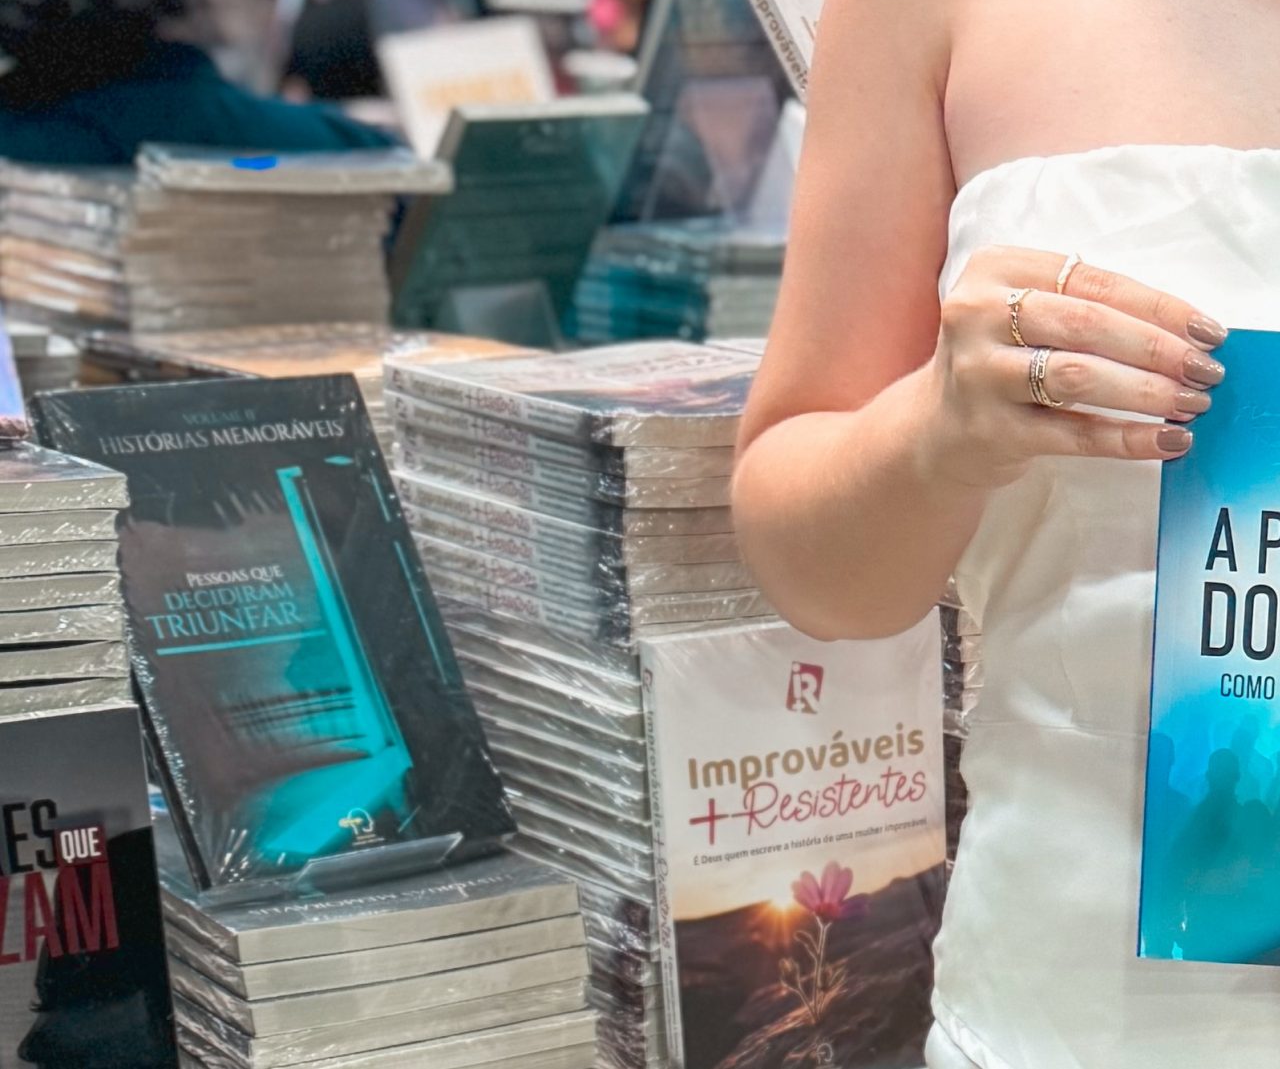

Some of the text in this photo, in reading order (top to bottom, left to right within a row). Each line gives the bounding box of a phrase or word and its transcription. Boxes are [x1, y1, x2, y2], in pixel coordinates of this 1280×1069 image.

[99, 418, 345, 455] HISTÓRIAS MEMORÁVEIS
[1205, 507, 1238, 572] A
[185, 565, 285, 588] PESSOAS QUE
[163, 581, 295, 611] DECIDIRAM
[144, 601, 302, 639] TRIUNFAR
[1200, 581, 1279, 661] DO
[1220, 673, 1275, 700] COMO
[688, 722, 925, 790] Improváveis
[731, 766, 927, 836] Resistentes
[59, 827, 102, 863] QUE
[701, 854, 722, 865] Deus
[724, 849, 749, 862] quem
[750, 843, 782, 856] escreve
[791, 835, 821, 849] história
[823, 834, 834, 843] de
